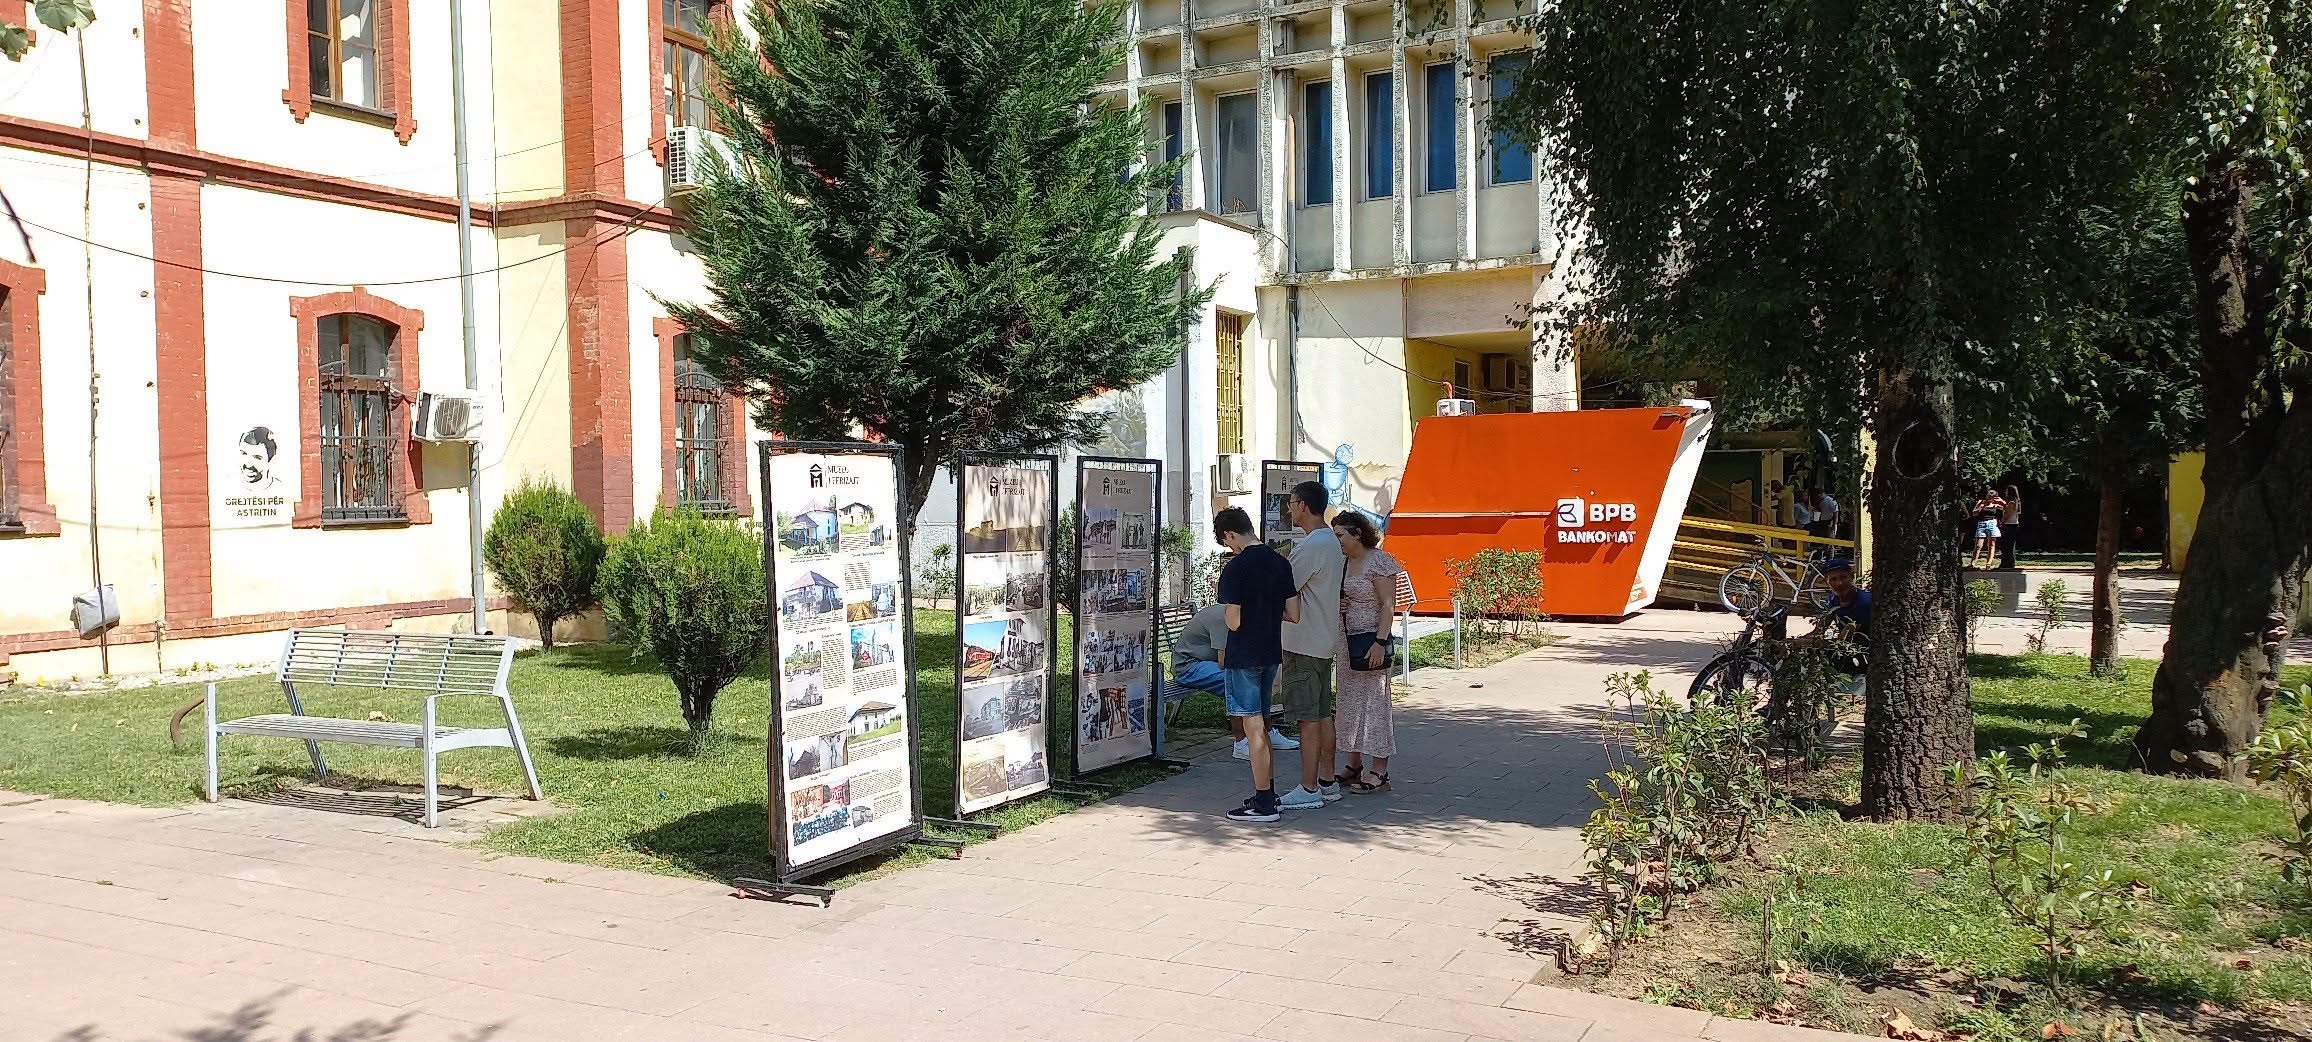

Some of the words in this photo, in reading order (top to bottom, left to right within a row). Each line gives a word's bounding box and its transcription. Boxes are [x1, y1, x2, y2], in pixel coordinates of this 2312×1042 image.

[267, 496, 284, 506] PËR
[237, 508, 277, 517] ASTRITIN
[1589, 503, 1637, 522] BPB
[1557, 530, 1637, 544] BANKOMAT
